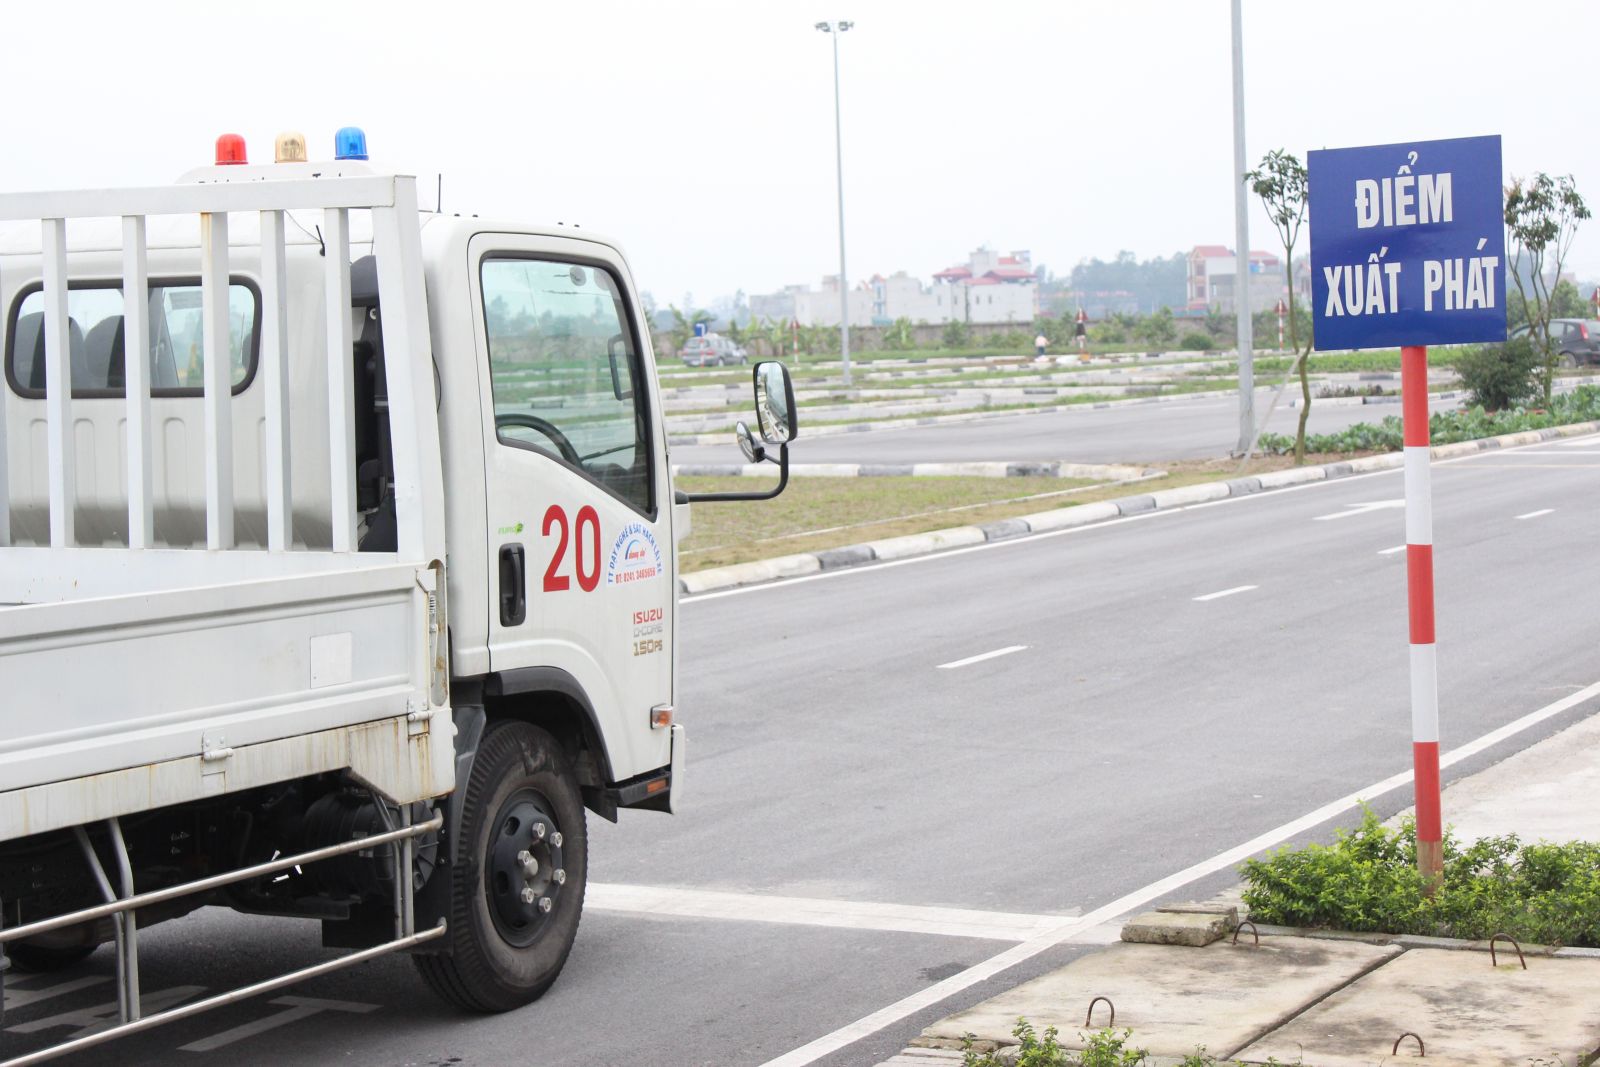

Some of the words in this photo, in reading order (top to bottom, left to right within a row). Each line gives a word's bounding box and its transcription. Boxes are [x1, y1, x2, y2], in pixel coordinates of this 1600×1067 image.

[1355, 151, 1453, 229] ĐIỂM
[1323, 246, 1401, 317] XUẤT
[1423, 238, 1499, 312] PHÁT
[542, 504, 601, 592] 20
[633, 608, 662, 624] ISUZU
